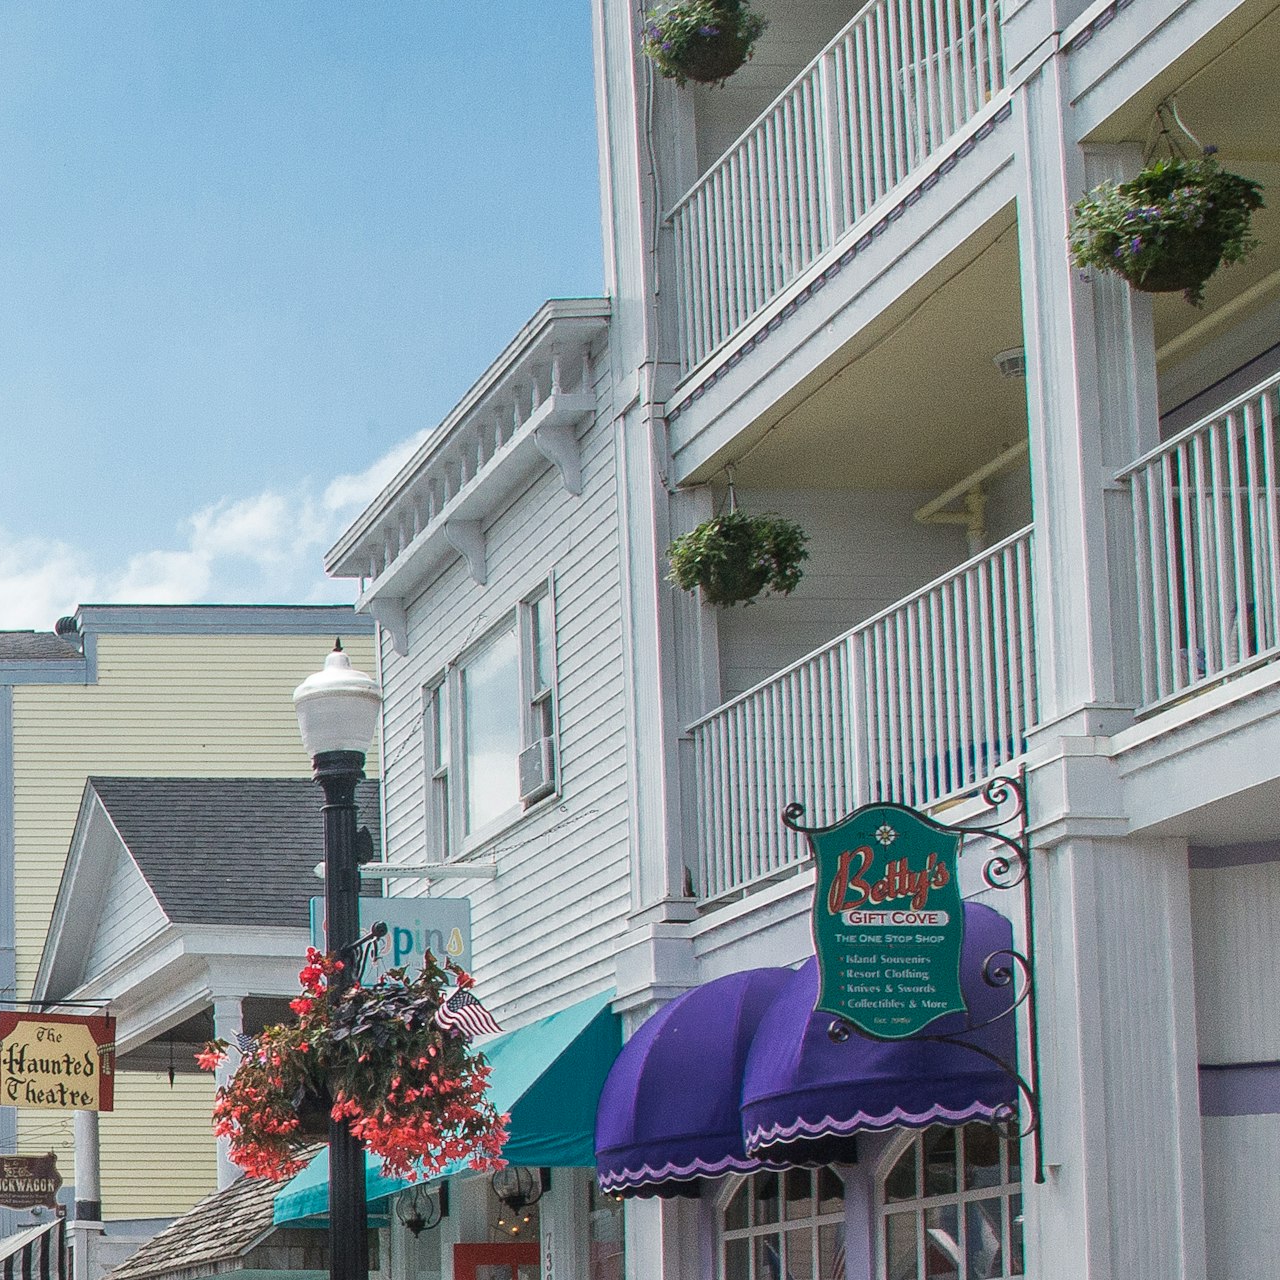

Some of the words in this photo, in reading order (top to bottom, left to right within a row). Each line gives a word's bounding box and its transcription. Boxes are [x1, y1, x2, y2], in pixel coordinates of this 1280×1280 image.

[828, 845, 950, 916] Betty's
[848, 911, 887, 924] GIFT
[891, 911, 939, 924] COVE
[834, 933, 857, 943] THE
[858, 933, 883, 943] ONE
[884, 934, 913, 943] STOP
[915, 934, 945, 943] SHOP
[845, 954, 877, 964] Island
[880, 954, 931, 964] Souvenirs
[846, 968, 880, 978] Resort
[884, 968, 930, 981] Clothing
[846, 983, 881, 993] Knives
[885, 984, 894, 993] &
[897, 983, 936, 993] Swords
[847, 998, 905, 1009] Collectibles
[908, 999, 918, 1008] &
[921, 999, 948, 1009] More
[36, 1026, 63, 1043] The
[2, 1042, 95, 1077] Haunted
[4, 1076, 94, 1107] Theatre
